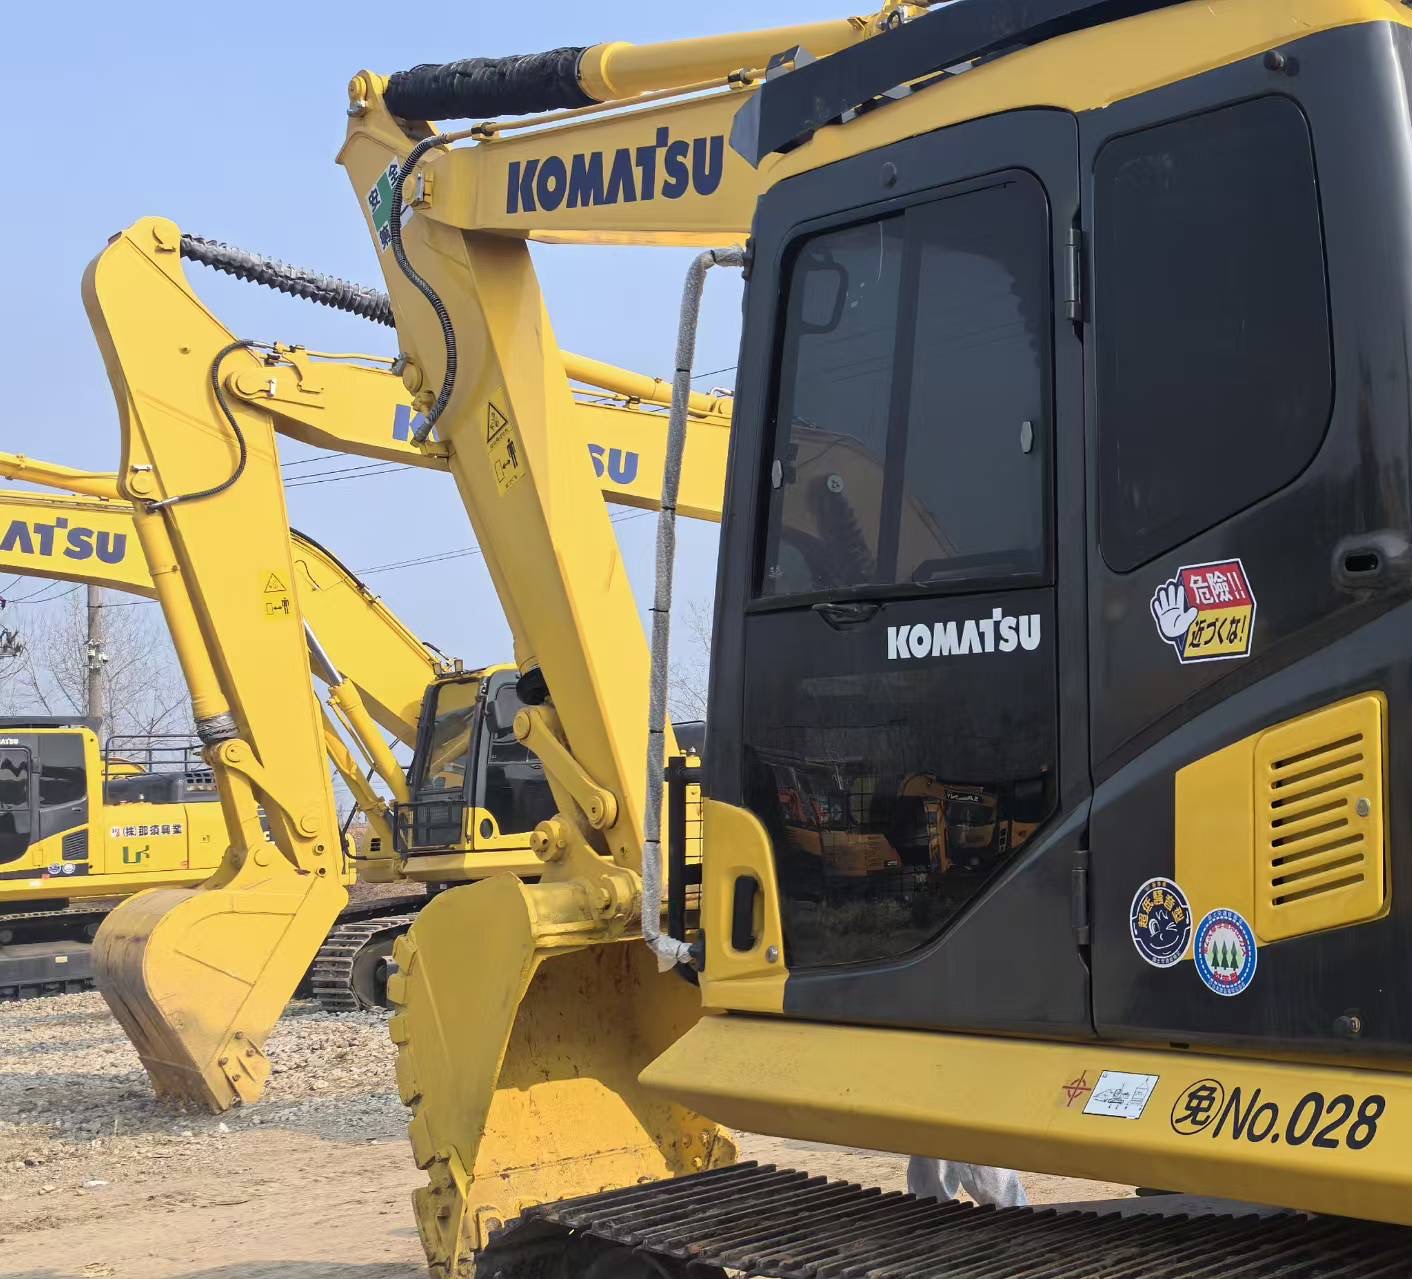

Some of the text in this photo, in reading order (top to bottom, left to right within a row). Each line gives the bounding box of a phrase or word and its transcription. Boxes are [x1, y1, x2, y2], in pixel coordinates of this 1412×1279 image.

[506, 127, 724, 214] KOMATSU
[0, 516, 127, 564] ATSU
[887, 607, 1041, 660] KOMATSU
[1212, 1086, 1386, 1150] No.028
